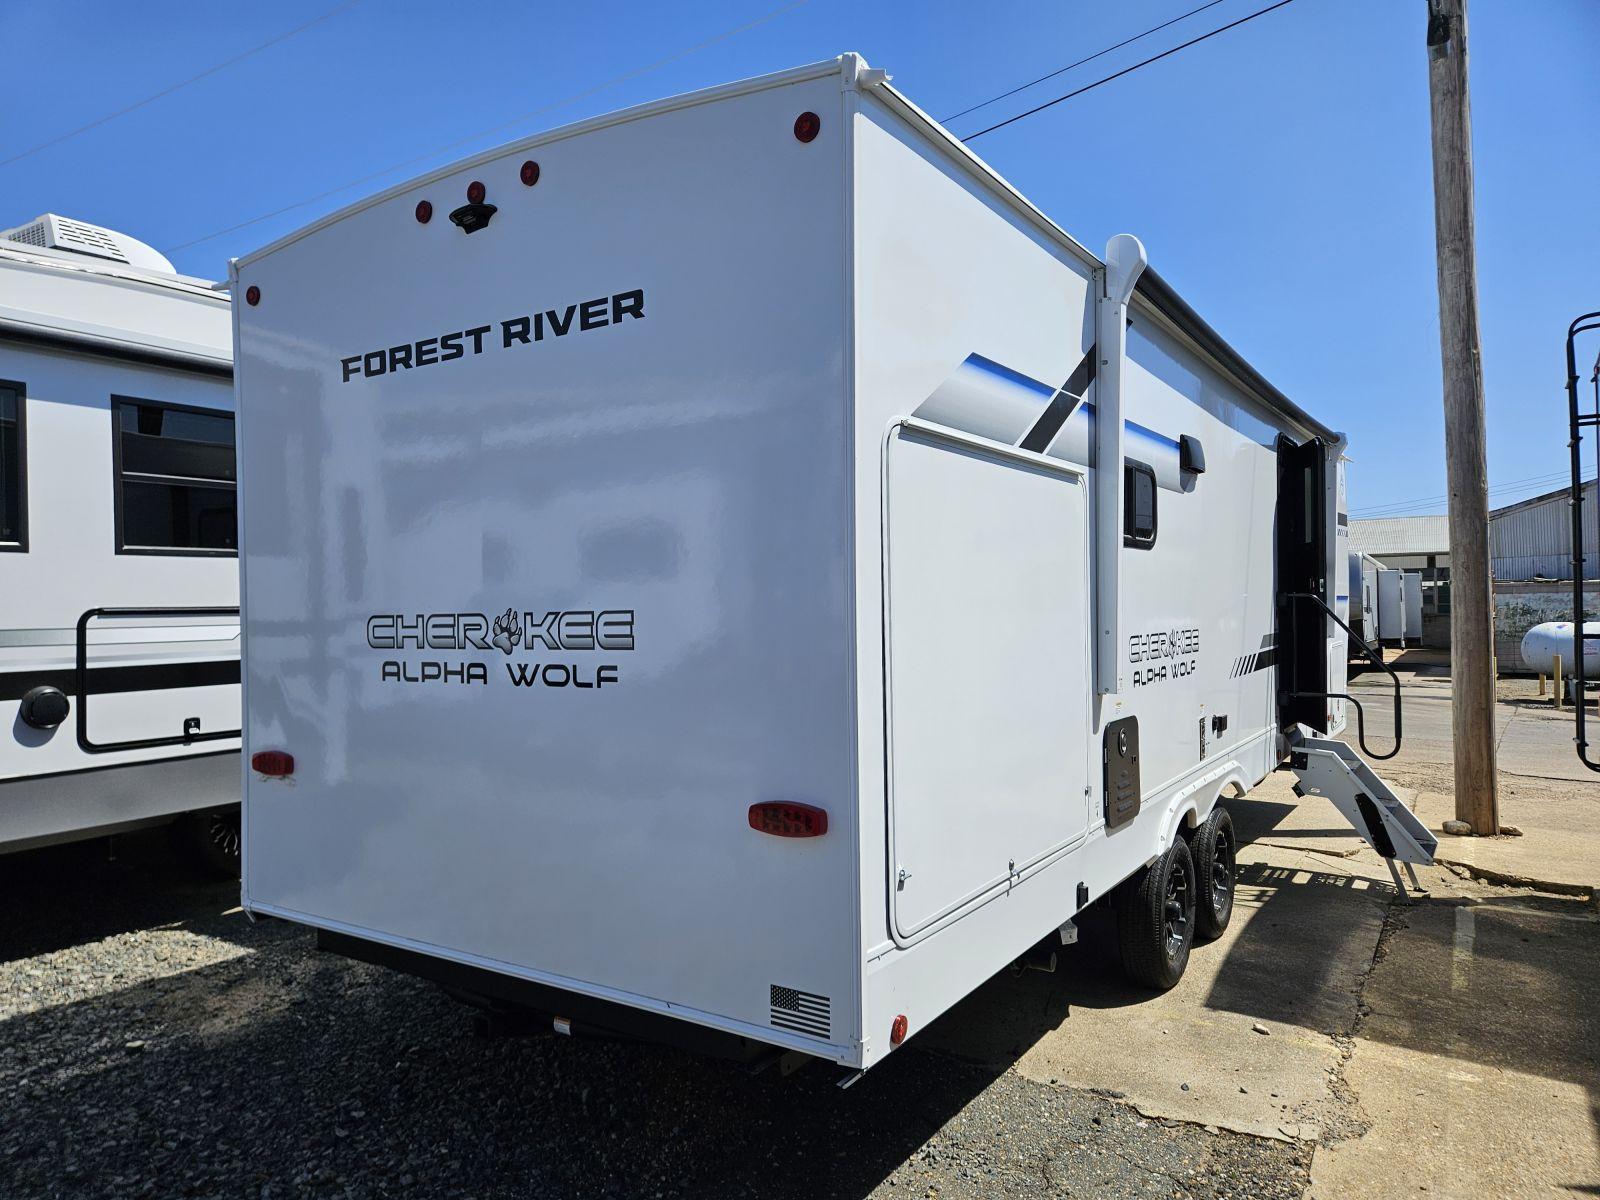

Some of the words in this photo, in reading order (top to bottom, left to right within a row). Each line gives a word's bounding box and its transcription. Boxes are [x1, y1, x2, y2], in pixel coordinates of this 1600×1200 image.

[340, 325, 491, 383] FOREST
[500, 288, 646, 348] RIVER
[382, 660, 488, 685] ALPHA
[506, 663, 618, 689] WOLF
[1133, 665, 1167, 688] ALPHA
[1171, 659, 1196, 680] WOLF
